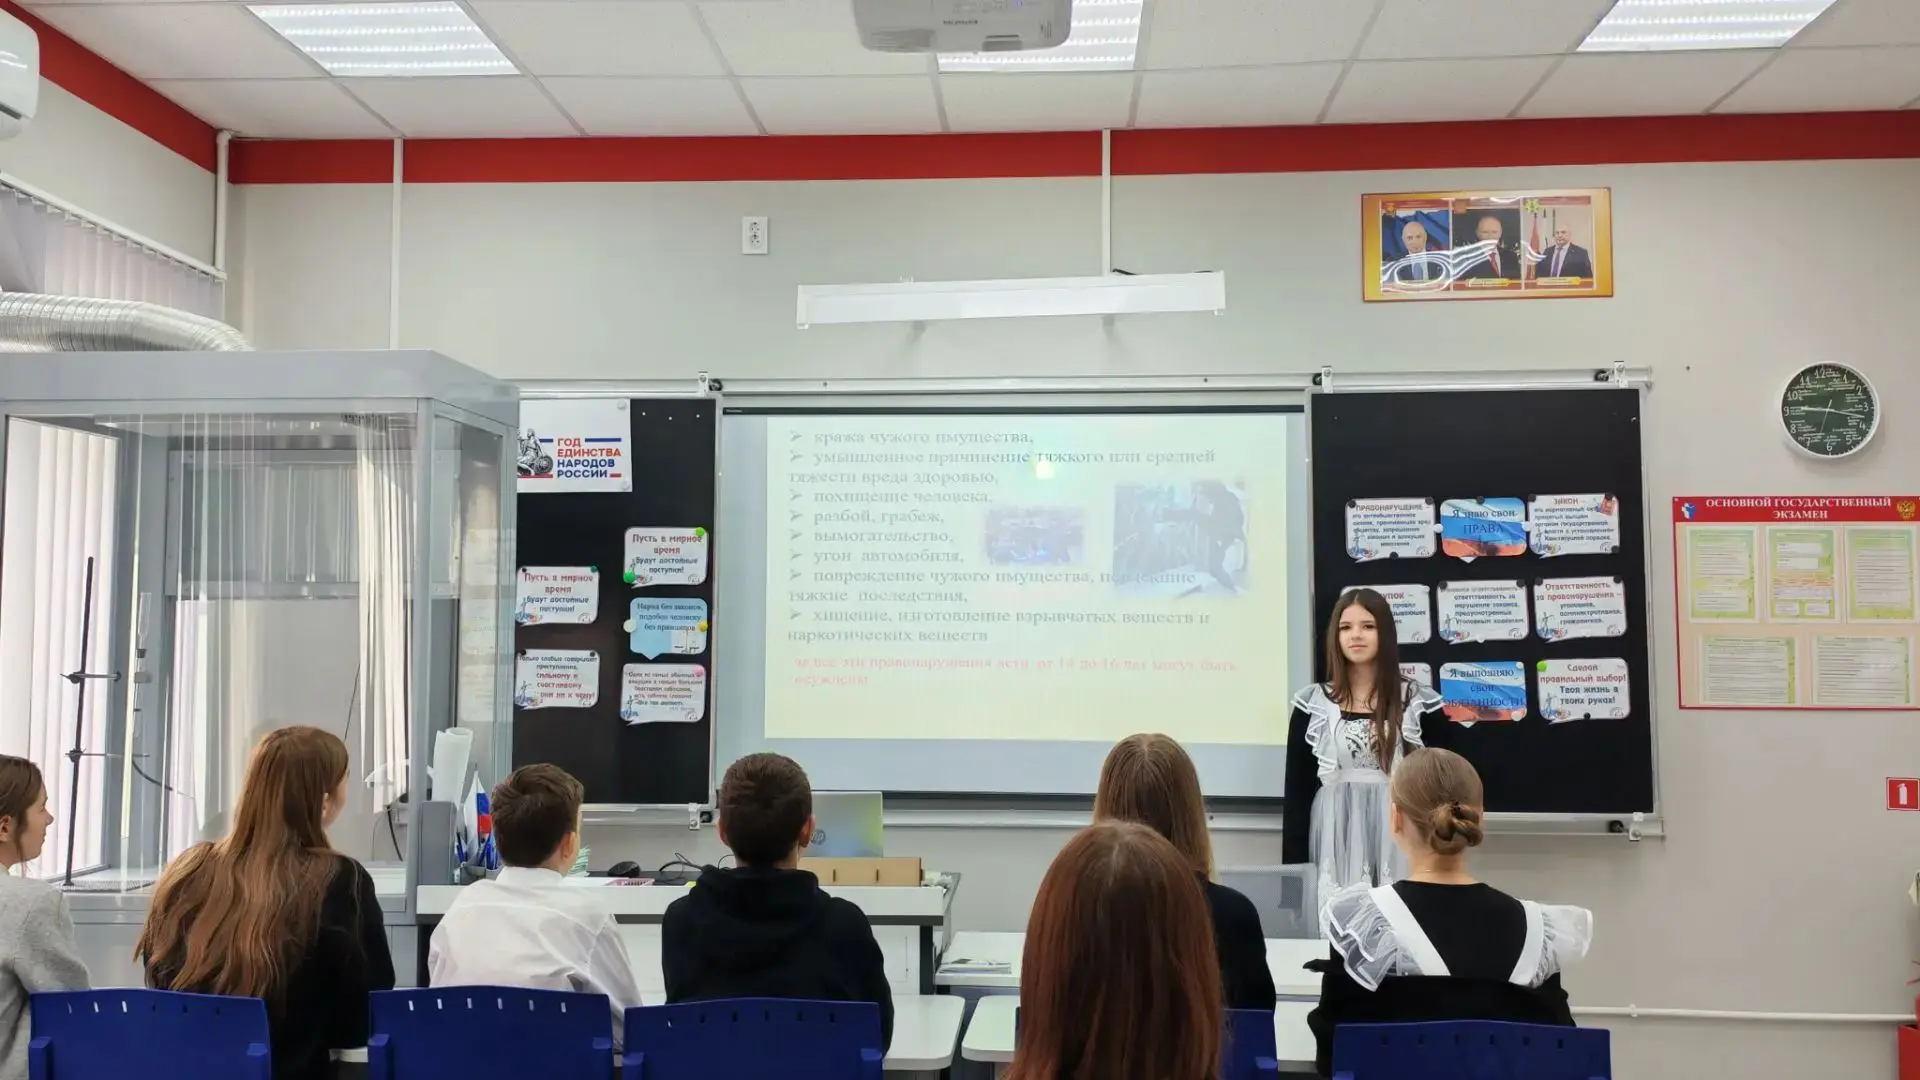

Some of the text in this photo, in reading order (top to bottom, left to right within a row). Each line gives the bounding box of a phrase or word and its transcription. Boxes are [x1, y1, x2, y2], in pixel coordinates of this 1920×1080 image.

[1814, 368, 1825, 378] 12
[1800, 376, 1810, 385] 11
[1787, 391, 1798, 400] 10
[1856, 386, 1862, 395] 2
[1784, 406, 1789, 416] 9
[1863, 402, 1869, 412] 3
[1790, 424, 1796, 433] 8
[557, 438, 581, 447] ГОД
[814, 432, 1034, 447] кража чужого имущества,
[1846, 435, 1852, 445] 5
[557, 448, 621, 458] ЕДИНСТВА
[814, 452, 924, 466] умышленное
[929, 451, 1030, 466] причинение
[1109, 452, 1140, 463] или
[1145, 448, 1215, 466] средней
[557, 459, 615, 468] НАРОДОВ
[557, 469, 607, 478] РОССИИ
[788, 472, 856, 483] тяжести
[862, 472, 908, 487] вреда
[814, 492, 909, 503] похищение
[1706, 497, 1891, 507] ОСНОВНОЙ ГОСУДАРСТВЕННЫЙ
[814, 510, 944, 526] разбой, грабеж,
[1452, 510, 1459, 518] Я
[1772, 510, 1828, 519] ЭКЗАМЕН
[1464, 524, 1504, 534] ПРАВА
[632, 534, 657, 543] Пусть
[814, 531, 953, 543] вымогательство,
[814, 549, 964, 565] угон автомобиля,
[524, 573, 548, 582] Пусть
[561, 575, 593, 583] мирное
[814, 571, 925, 585] повреждение
[930, 571, 989, 585] чужого
[995, 572, 1095, 586] имущества,
[545, 586, 572, 594] время
[1545, 582, 1610, 591] Ответственность
[788, 591, 968, 604] тяжкие последствия,
[1547, 593, 1614, 601] правонарушения
[898, 610, 1010, 623] изготовление
[1016, 612, 1117, 625] взрывчатых
[1122, 612, 1193, 625] веществ
[1200, 613, 1209, 624] и
[788, 630, 988, 643] наркотических веществ
[1450, 669, 1514, 677] Я выполняю
[1540, 673, 1626, 684] правильный выбор!
[1588, 697, 1615, 705] руках!
